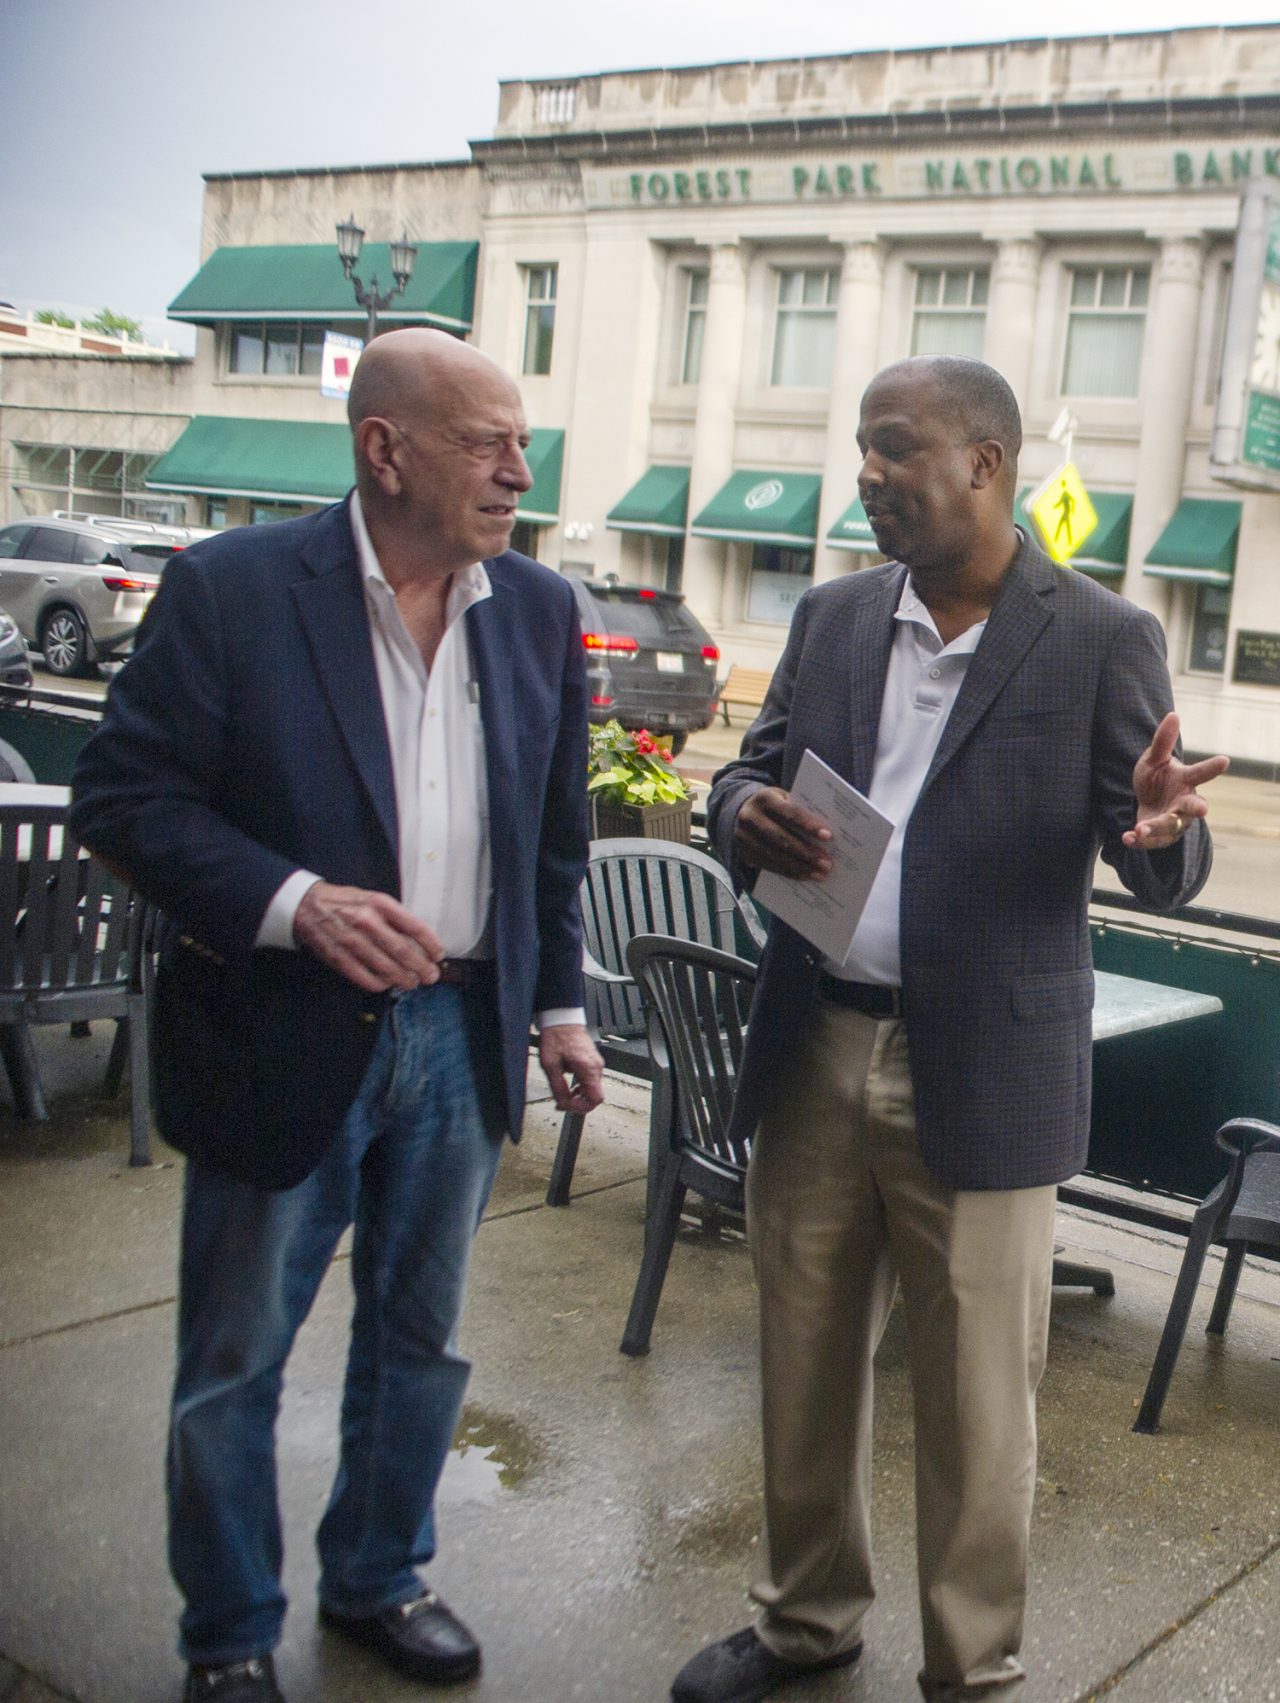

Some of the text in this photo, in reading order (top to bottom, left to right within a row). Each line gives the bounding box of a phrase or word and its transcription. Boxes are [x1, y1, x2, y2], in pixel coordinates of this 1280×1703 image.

[630, 168, 751, 200] FOREST
[792, 162, 881, 196] PARK
[925, 153, 1121, 191] NATIONAL
